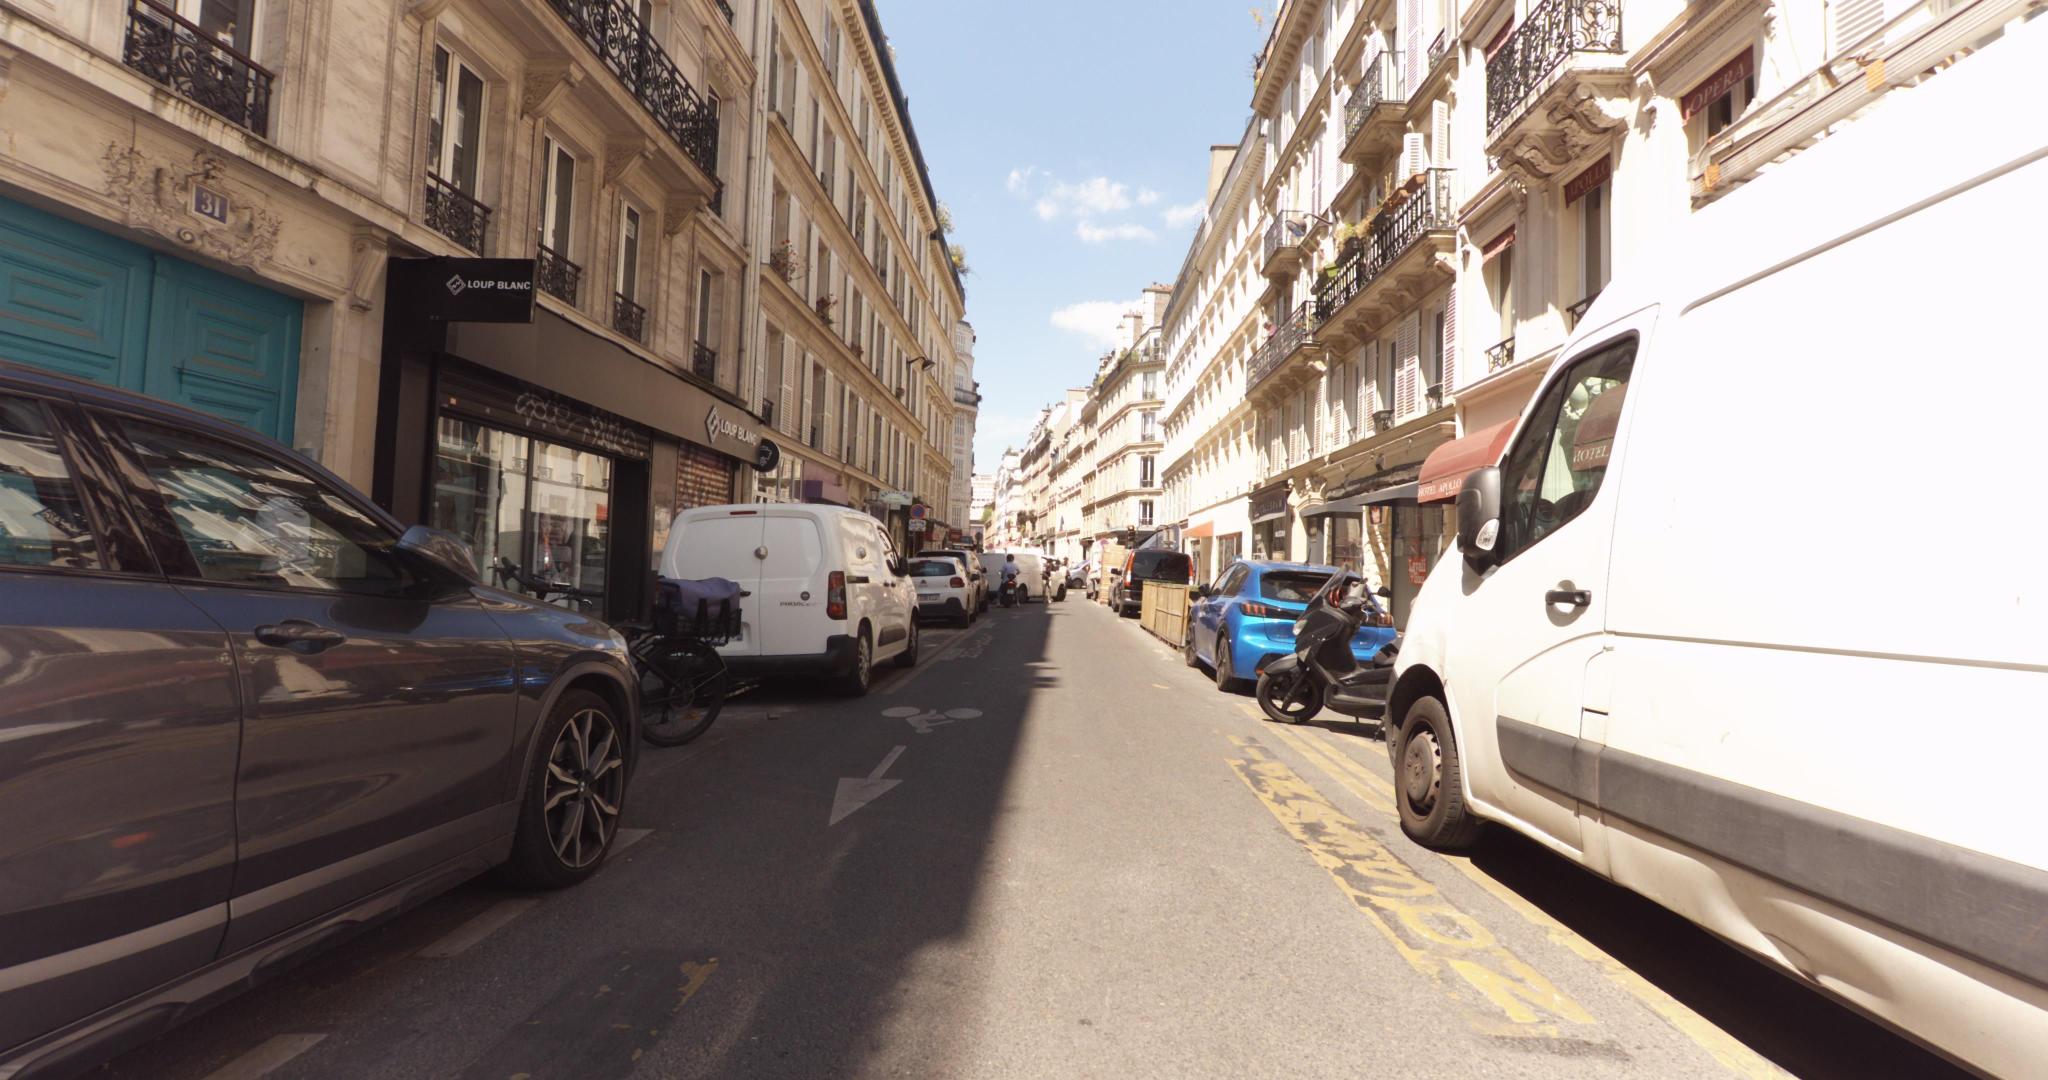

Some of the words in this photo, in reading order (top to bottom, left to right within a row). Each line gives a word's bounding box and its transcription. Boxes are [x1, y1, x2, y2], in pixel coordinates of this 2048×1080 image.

[1690, 62, 1745, 112] OPERA
[201, 192, 220, 217] 31
[467, 280, 495, 289] LOUP
[497, 281, 531, 290] BLANC
[720, 419, 738, 436] LOUP
[1574, 445, 1609, 463] HOTEL
[1418, 485, 1437, 497] HOTEL
